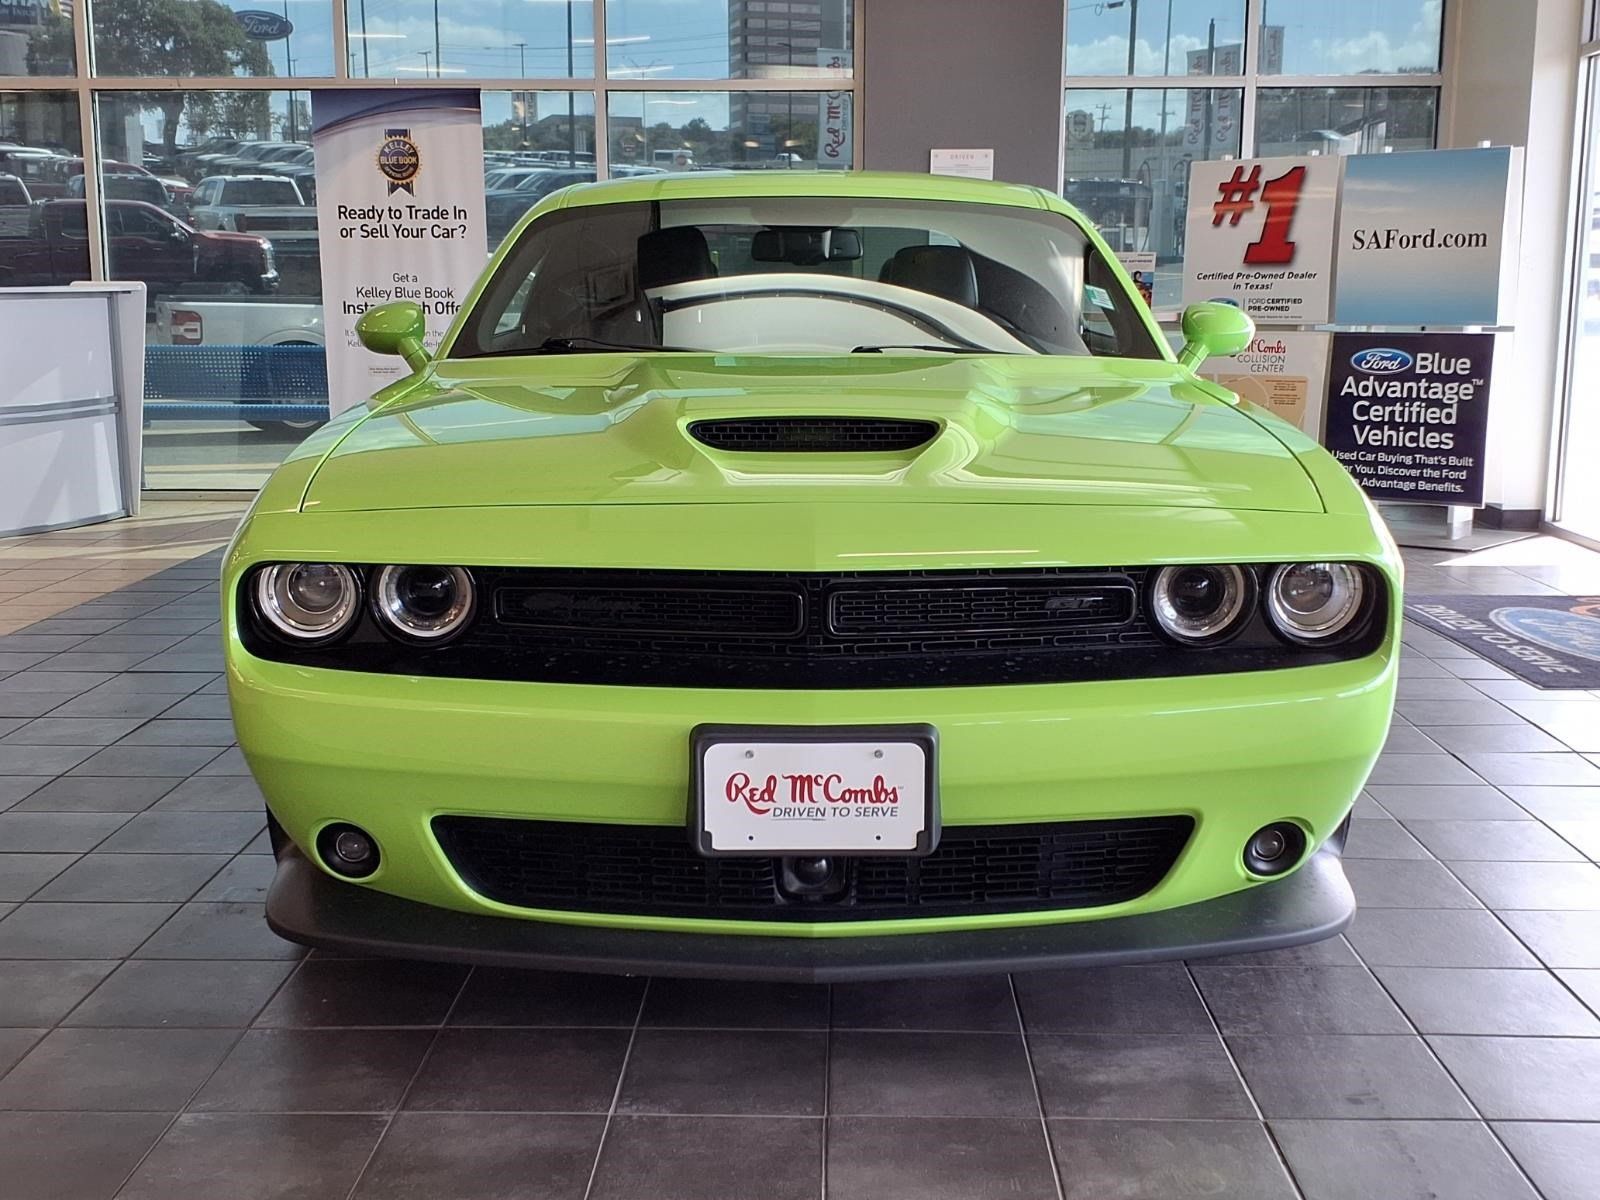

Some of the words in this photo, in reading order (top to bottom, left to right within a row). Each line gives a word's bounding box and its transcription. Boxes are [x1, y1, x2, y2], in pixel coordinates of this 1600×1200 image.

[244, 14, 280, 34] Ford
[384, 141, 414, 154] KELLEY
[824, 127, 846, 158] Red
[380, 156, 399, 165] BLUE
[398, 156, 418, 165] BOOK
[337, 205, 384, 223] Ready
[388, 206, 403, 220] to
[405, 205, 449, 220] Trade
[453, 205, 467, 220] In
[1212, 165, 1306, 266] #1
[340, 226, 356, 238] or
[360, 224, 389, 239] Sell
[392, 224, 427, 239] Your
[430, 224, 467, 239] Car?
[1351, 228, 1488, 251] SAFord.com
[392, 272, 410, 283] Get
[411, 275, 418, 283] a
[1196, 272, 1234, 280] Certified
[1235, 272, 1285, 280] Pre-Owned
[1287, 271, 1317, 280] Dealer
[356, 286, 392, 301] Kelley
[394, 286, 422, 299] Blue
[424, 286, 455, 299] Book
[1232, 282, 1242, 290] in
[1244, 282, 1273, 290] Texas!
[1237, 354, 1286, 364] COLLISION
[1361, 352, 1402, 370] Ford
[1415, 352, 1471, 375] Blue
[1250, 364, 1285, 373] CENTER
[1352, 400, 1458, 424] Certified
[1352, 425, 1455, 450] Vehicles
[1358, 451, 1376, 461] Car
[1377, 453, 1412, 465] Buying
[1414, 454, 1446, 466] That's
[1448, 456, 1474, 467] Built
[1354, 464, 1376, 474] You.
[1377, 466, 1421, 477] Discover
[1423, 468, 1440, 478] the
[1441, 469, 1467, 480] Ford
[1360, 478, 1416, 491] Advantage
[1417, 481, 1464, 493] Benefits.
[1413, 604, 1494, 631] DRIVEN
[1497, 645, 1581, 674] SERVE
[726, 773, 778, 815] Red
[782, 774, 899, 804] McCombs
[772, 807, 826, 818] DRIVEN
[831, 807, 850, 817] TO
[854, 806, 899, 817] SERVE
